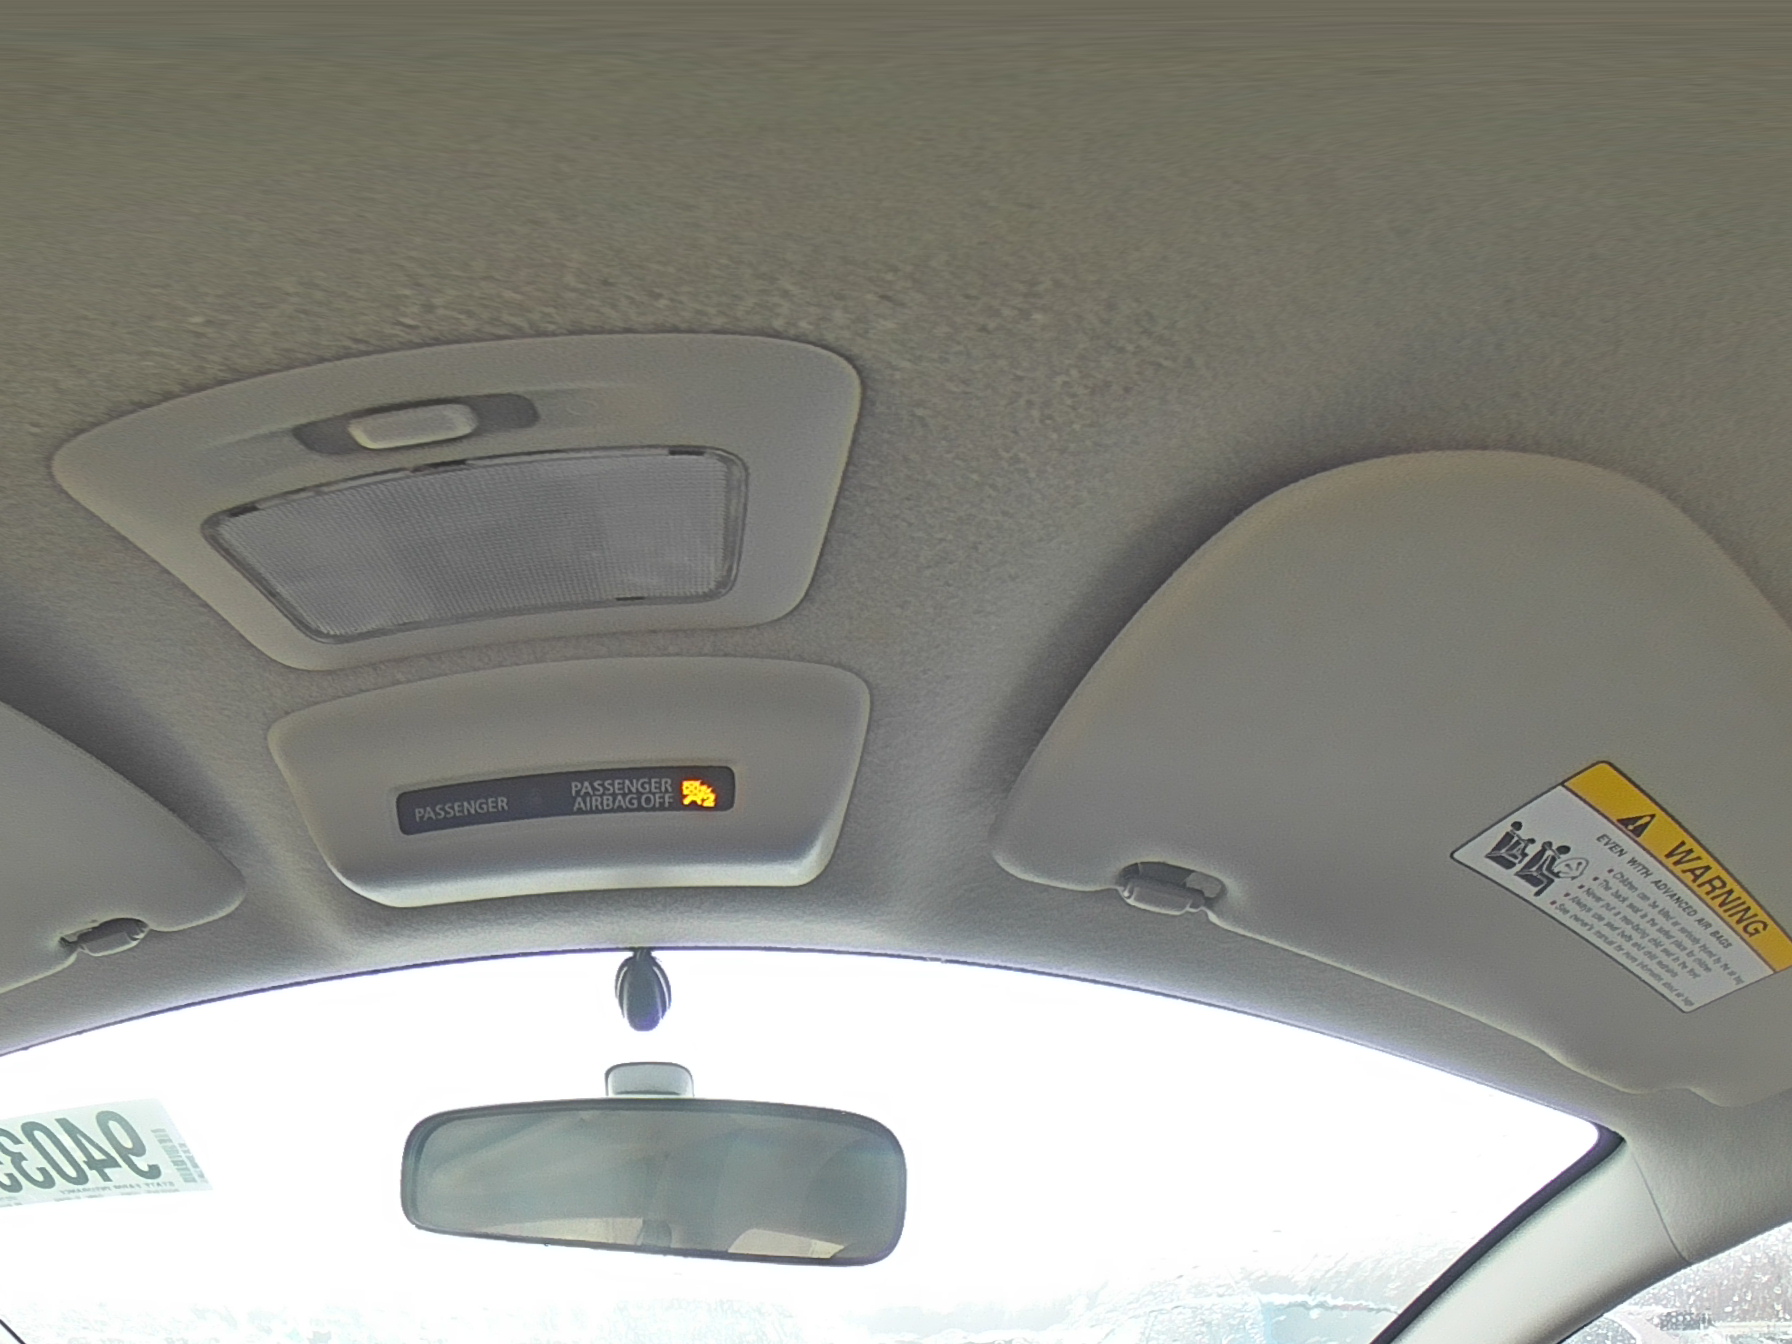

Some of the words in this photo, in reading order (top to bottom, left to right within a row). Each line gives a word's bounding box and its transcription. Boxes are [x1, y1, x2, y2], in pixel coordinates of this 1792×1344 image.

[571, 778, 673, 797] PASSENGER
[414, 797, 509, 822] PASSENGER
[573, 795, 638, 812] AIRBAG
[640, 794, 674, 808] OFF
[1594, 832, 1628, 858] EVEN
[1624, 857, 1654, 879] WITH
[1647, 877, 1699, 918] ADVANCED
[1693, 916, 1713, 931] AIR
[1707, 929, 1734, 949] BAGS
[1664, 841, 1768, 938] WARNING
